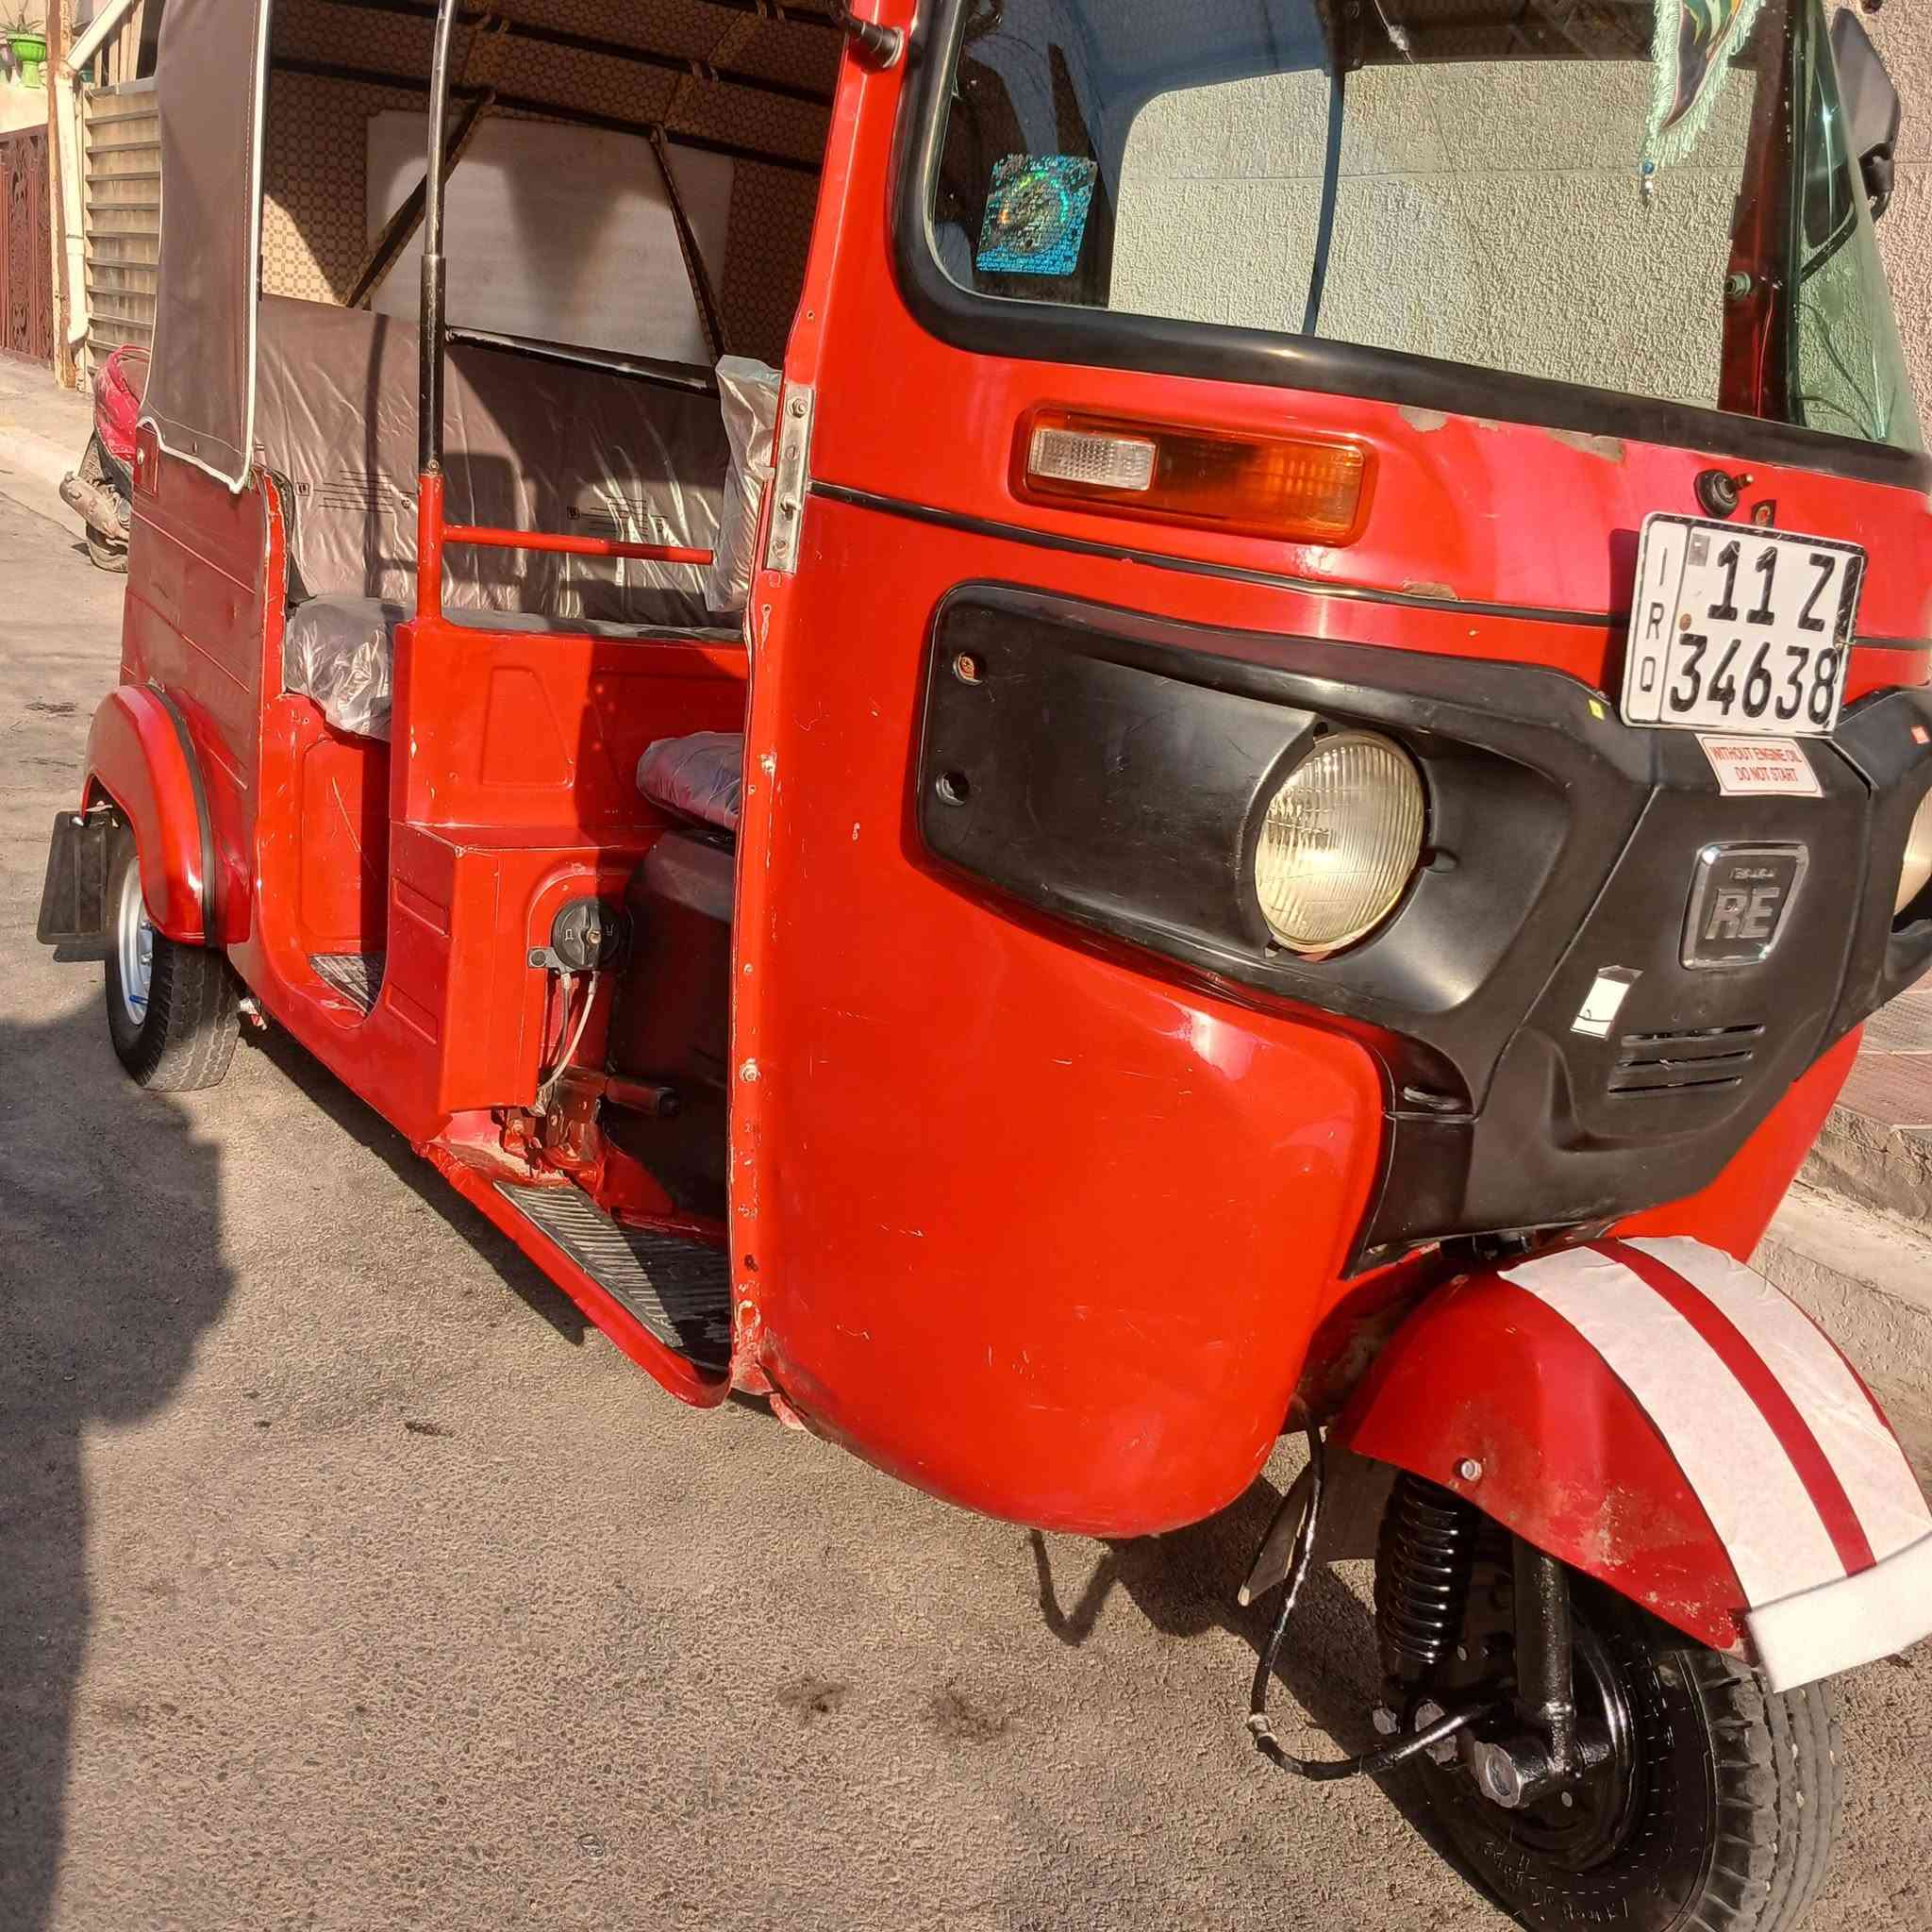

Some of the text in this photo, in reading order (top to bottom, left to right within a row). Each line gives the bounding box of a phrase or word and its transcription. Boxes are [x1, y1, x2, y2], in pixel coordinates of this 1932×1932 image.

[1639, 547, 1668, 692] IRQ
[1707, 541, 1836, 633] 11 Z
[1669, 634, 1840, 725] 34638
[1709, 746, 1752, 760] WITHOUT
[1734, 766, 1798, 782] DO NOT START
[1705, 887, 1781, 940] RE
